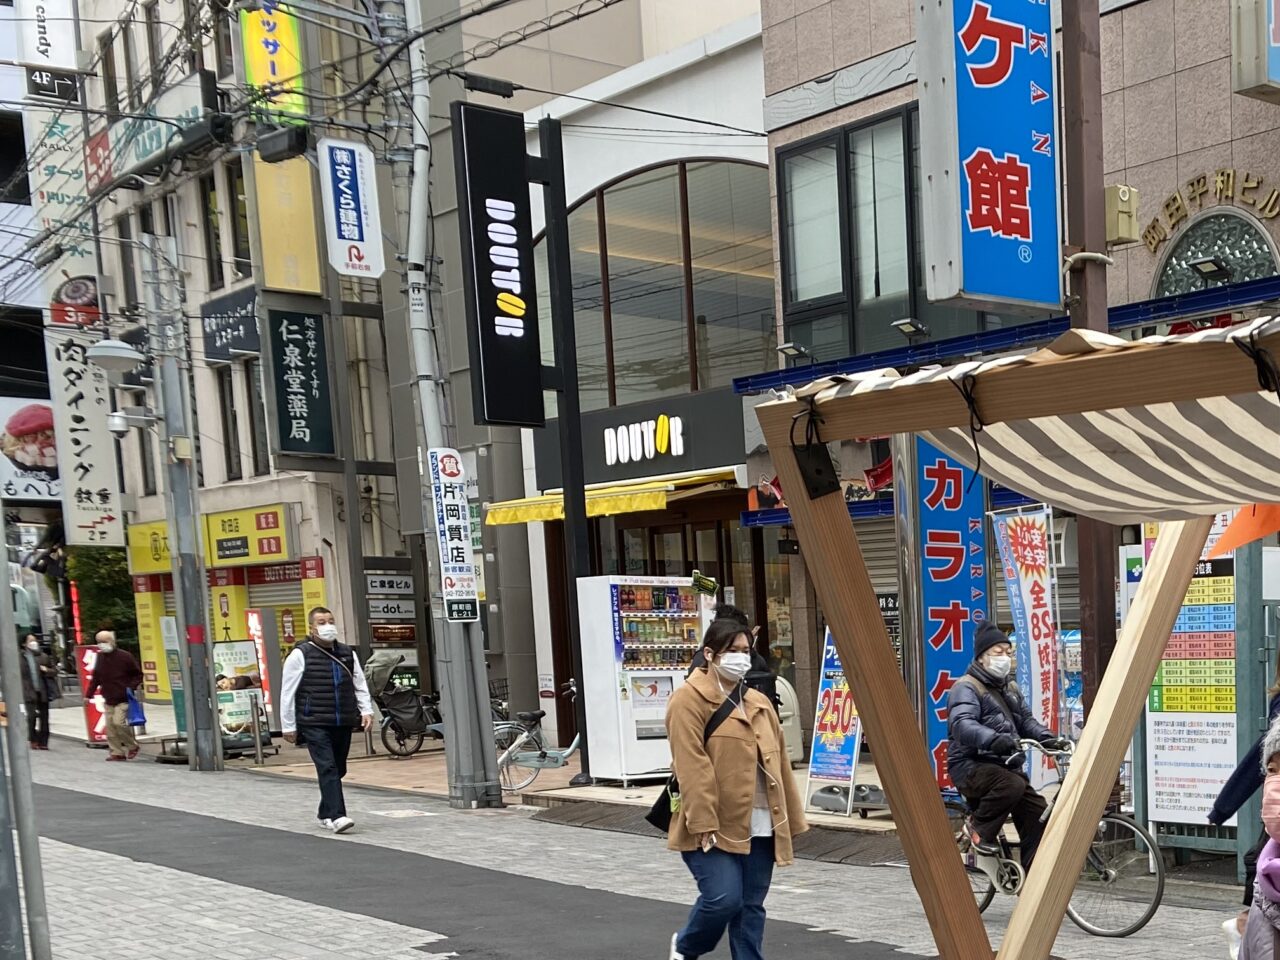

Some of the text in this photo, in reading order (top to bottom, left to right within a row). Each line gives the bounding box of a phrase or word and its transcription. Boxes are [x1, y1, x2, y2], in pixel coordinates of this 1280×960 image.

[36, 4, 51, 59] candy
[31, 70, 51, 85] 4F
[485, 198, 527, 338] DOUTOR
[64, 306, 87, 322] 3F
[278, 319, 311, 442] 仁泉堂薬局
[303, 316, 320, 399] 処方せん・くすり
[55, 337, 93, 481] 肉ダイニング
[604, 414, 684, 466] DOUTOR
[443, 483, 466, 563] 片岡質店
[817, 688, 856, 735] 250
